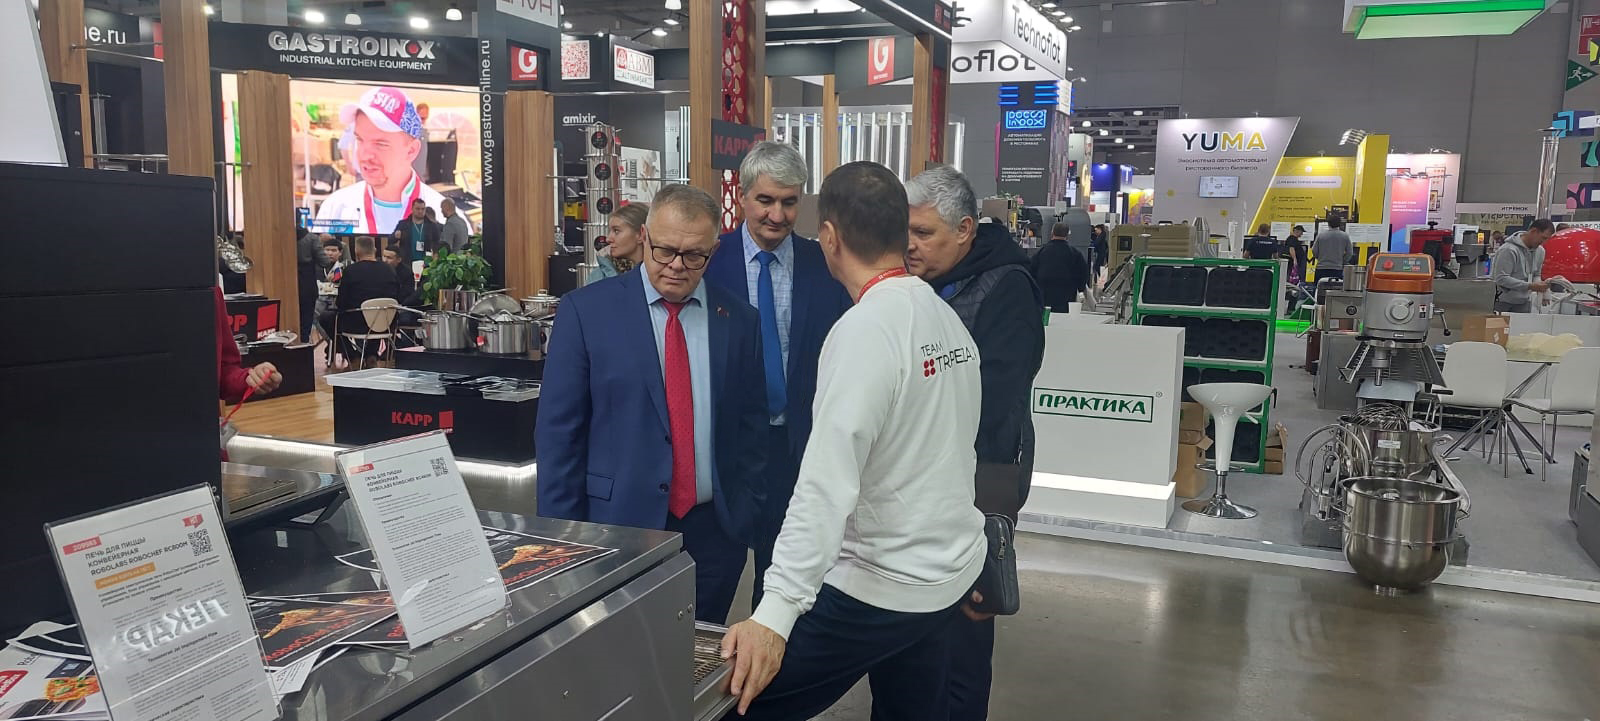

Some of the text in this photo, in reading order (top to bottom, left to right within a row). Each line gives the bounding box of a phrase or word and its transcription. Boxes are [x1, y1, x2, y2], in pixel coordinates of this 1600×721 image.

[268, 30, 436, 60] GASTROINOX
[1011, 5, 1061, 65] Technoflot
[279, 54, 432, 71] INDUSTRIAL KITCHEN EQUIPMENT
[479, 40, 495, 187] www.gastroonline.ru
[562, 113, 596, 124] amixir
[1182, 131, 1266, 151] YUMA
[920, 341, 944, 357] TEAM
[1039, 393, 1146, 415] ПРАКТИКА
[391, 411, 433, 427] KAPP
[85, 536, 146, 560] ПЕЧЬ ДЛЯ ПИЦЦЫ
[87, 547, 140, 568] КОНВЕЙЕРНАЯ
[90, 560, 128, 576] ROBOLABS
[128, 551, 163, 564] ROBOCHEF
